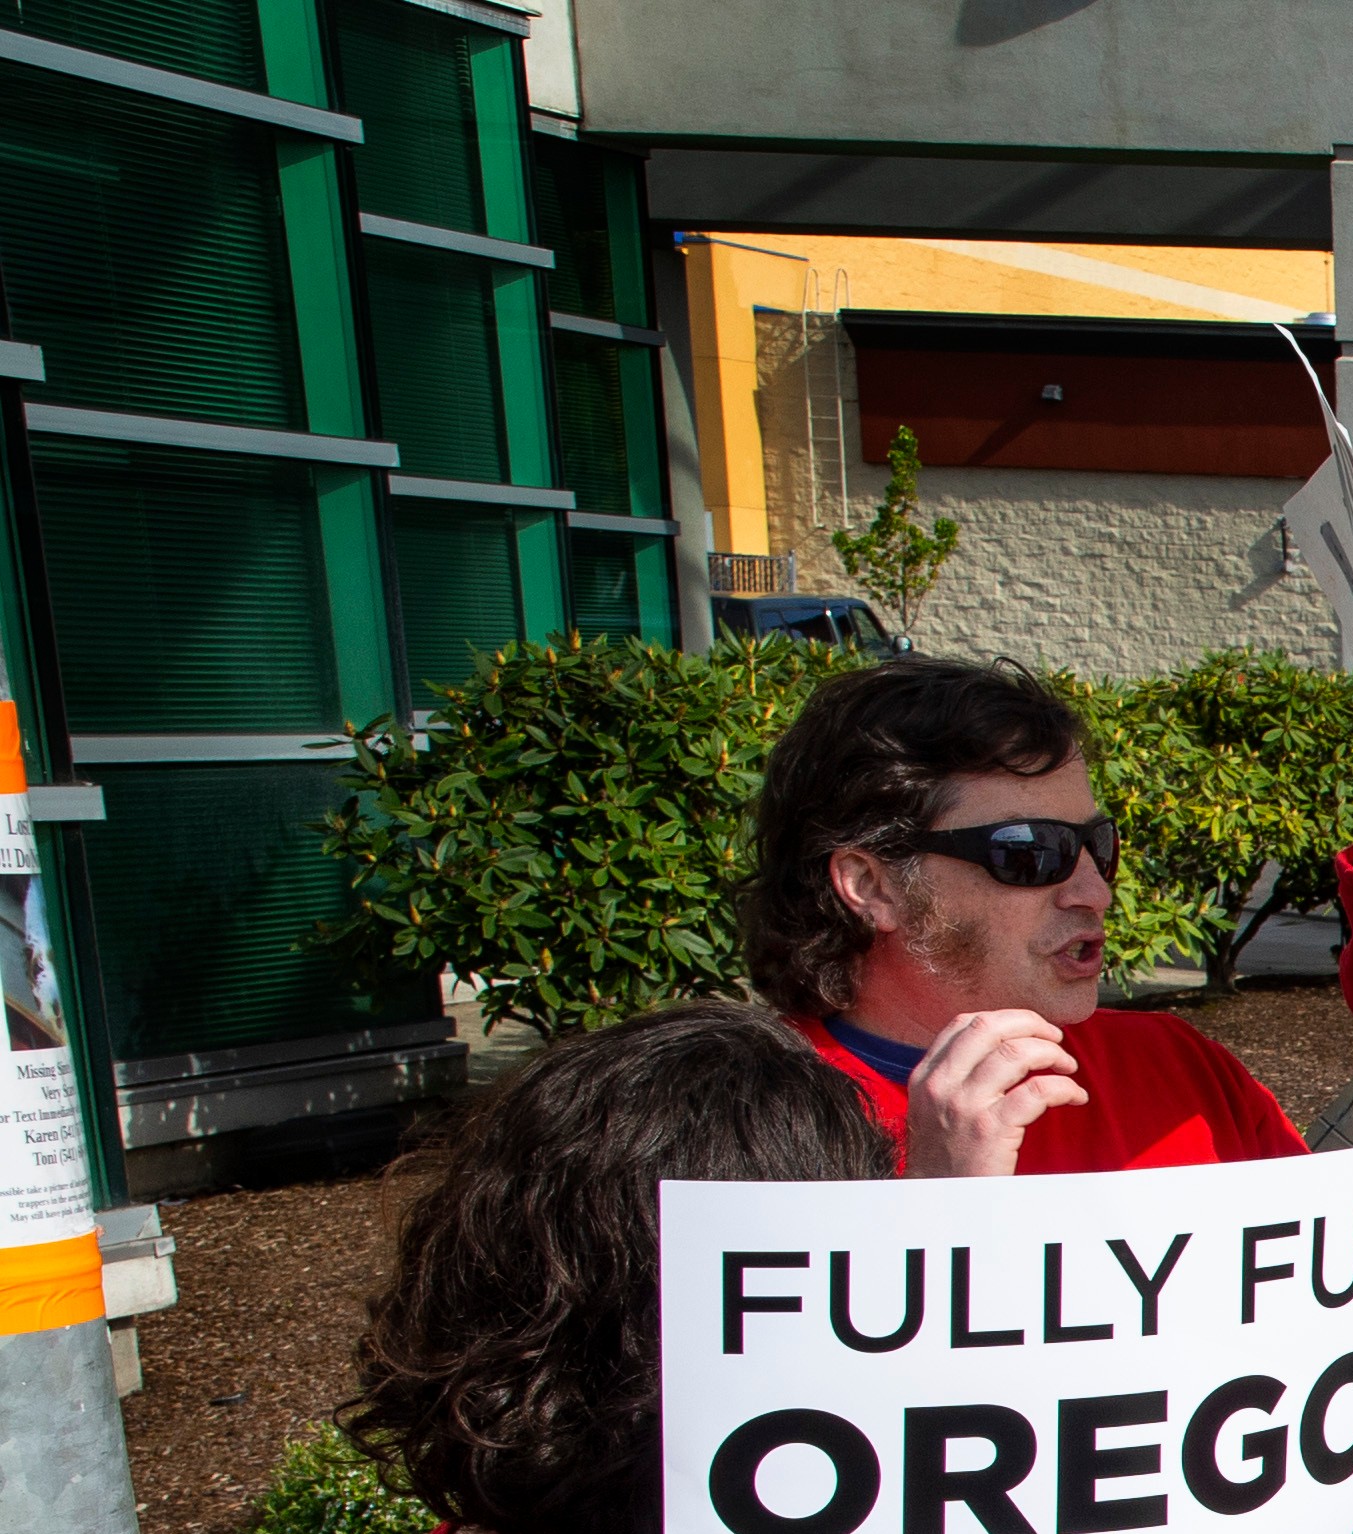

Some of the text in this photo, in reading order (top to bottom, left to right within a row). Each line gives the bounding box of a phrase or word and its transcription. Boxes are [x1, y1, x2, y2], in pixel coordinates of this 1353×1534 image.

[17, 1063, 57, 1081] Missing
[13, 1110, 37, 1123] Text
[24, 1129, 59, 1144] Karen
[33, 1149, 58, 1166] Toni
[722, 1232, 1193, 1356] FULLY
